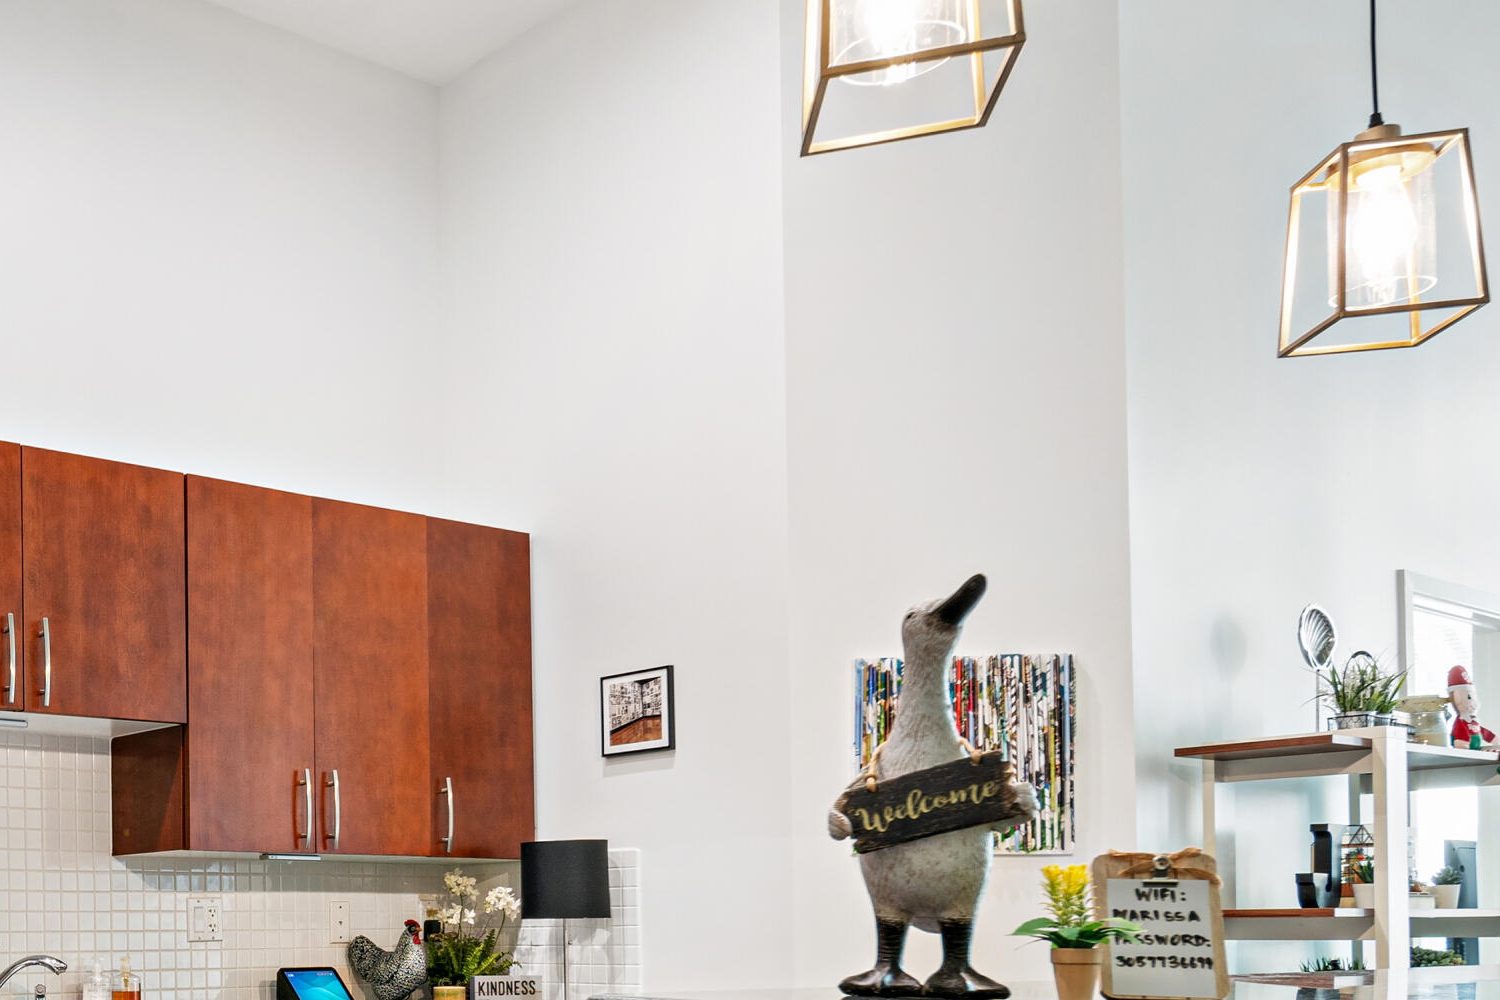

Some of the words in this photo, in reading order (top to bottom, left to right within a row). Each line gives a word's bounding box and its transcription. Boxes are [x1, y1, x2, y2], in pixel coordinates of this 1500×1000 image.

[855, 780, 1000, 832] Welcome
[1135, 888, 1187, 902] WIFI:
[1112, 909, 1201, 922] MARISSA
[478, 980, 536, 996] KINDNESS
